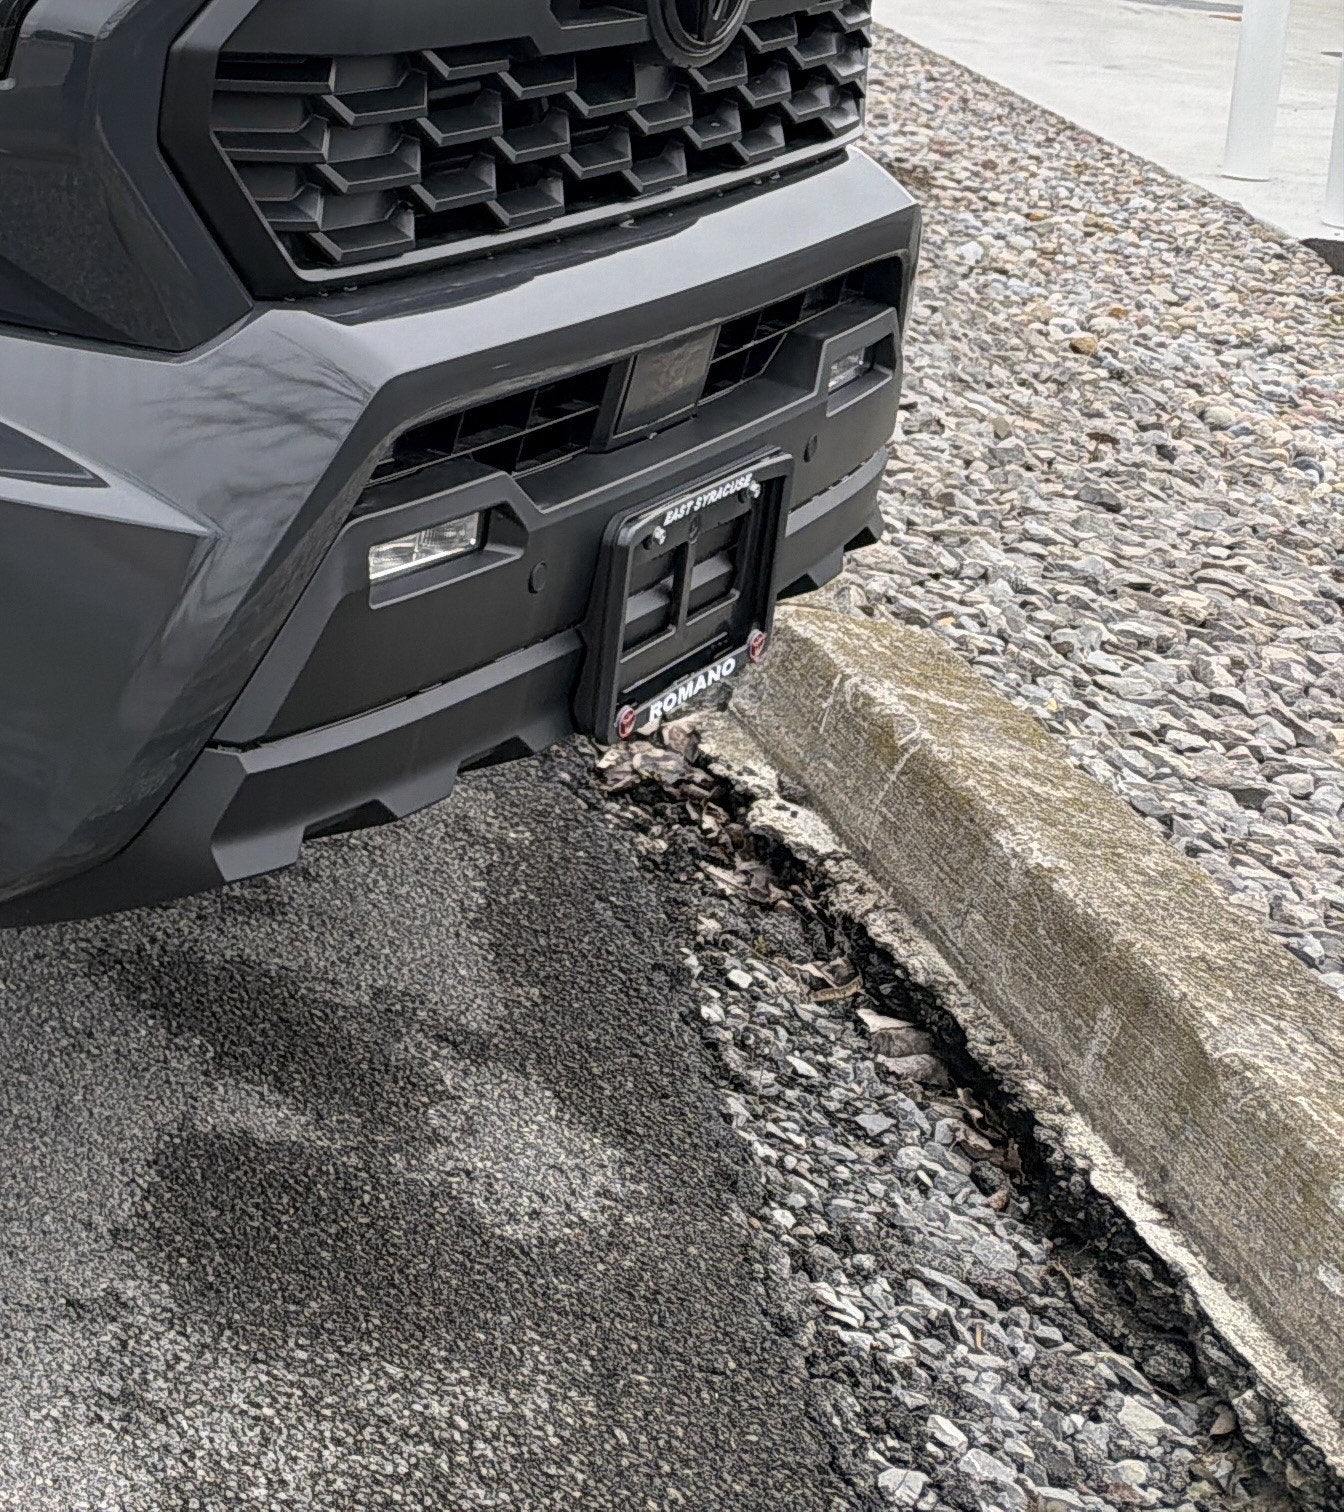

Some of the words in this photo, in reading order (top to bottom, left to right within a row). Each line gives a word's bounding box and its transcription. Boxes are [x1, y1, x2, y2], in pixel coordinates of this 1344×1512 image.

[663, 500, 694, 527] EAST
[694, 472, 753, 512] SYRACUSE
[648, 657, 736, 723] ROMANO
